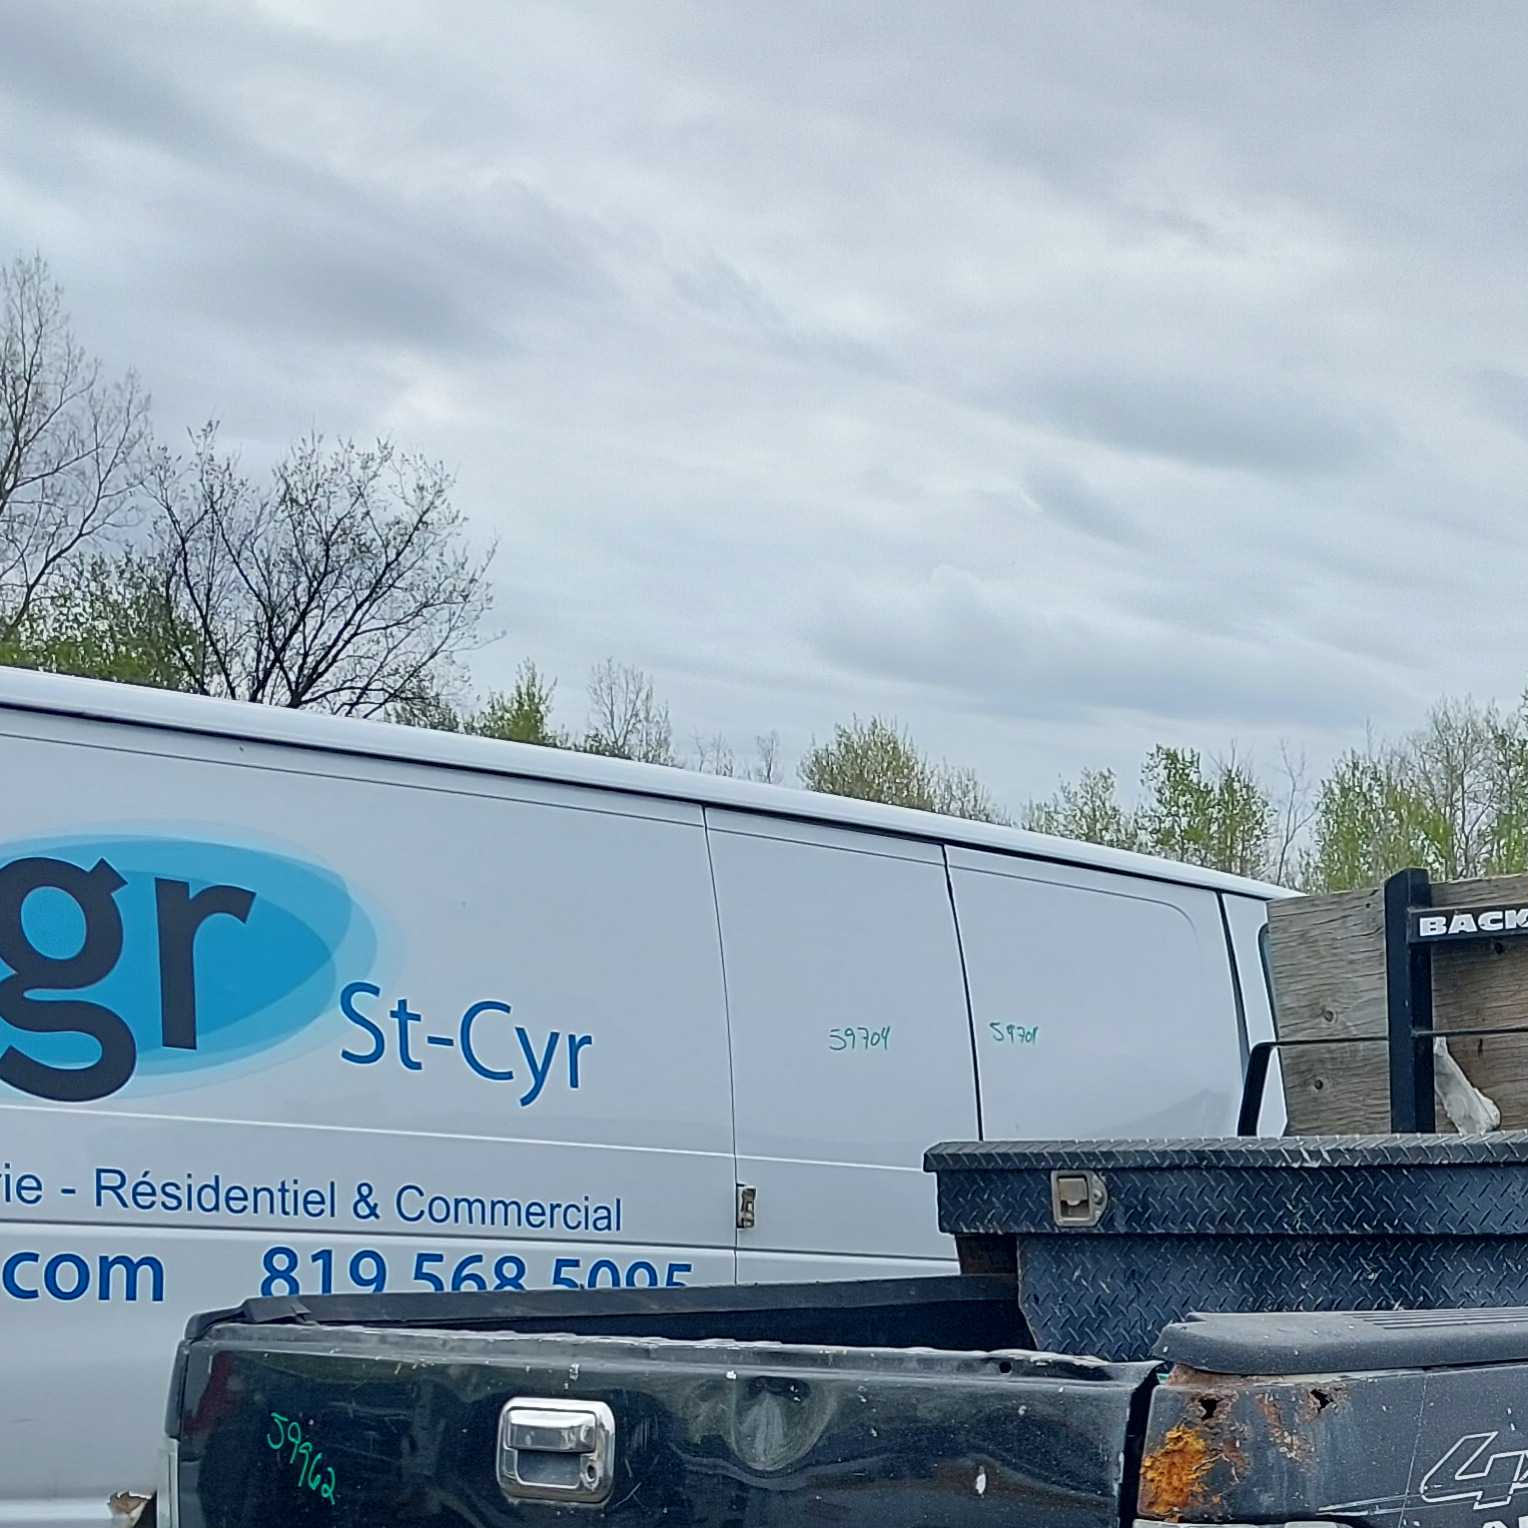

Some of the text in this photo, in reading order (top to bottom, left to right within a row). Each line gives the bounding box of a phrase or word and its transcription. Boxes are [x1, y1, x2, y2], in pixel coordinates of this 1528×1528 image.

[340, 981, 594, 1107] St-Cyr
[0, 1162, 43, 1205] ie
[95, 1167, 336, 1219] Résidentiel
[353, 1182, 380, 1221] &
[396, 1185, 622, 1233] Commercial
[260, 1246, 388, 1297] 819
[413, 1252, 528, 1292] 568
